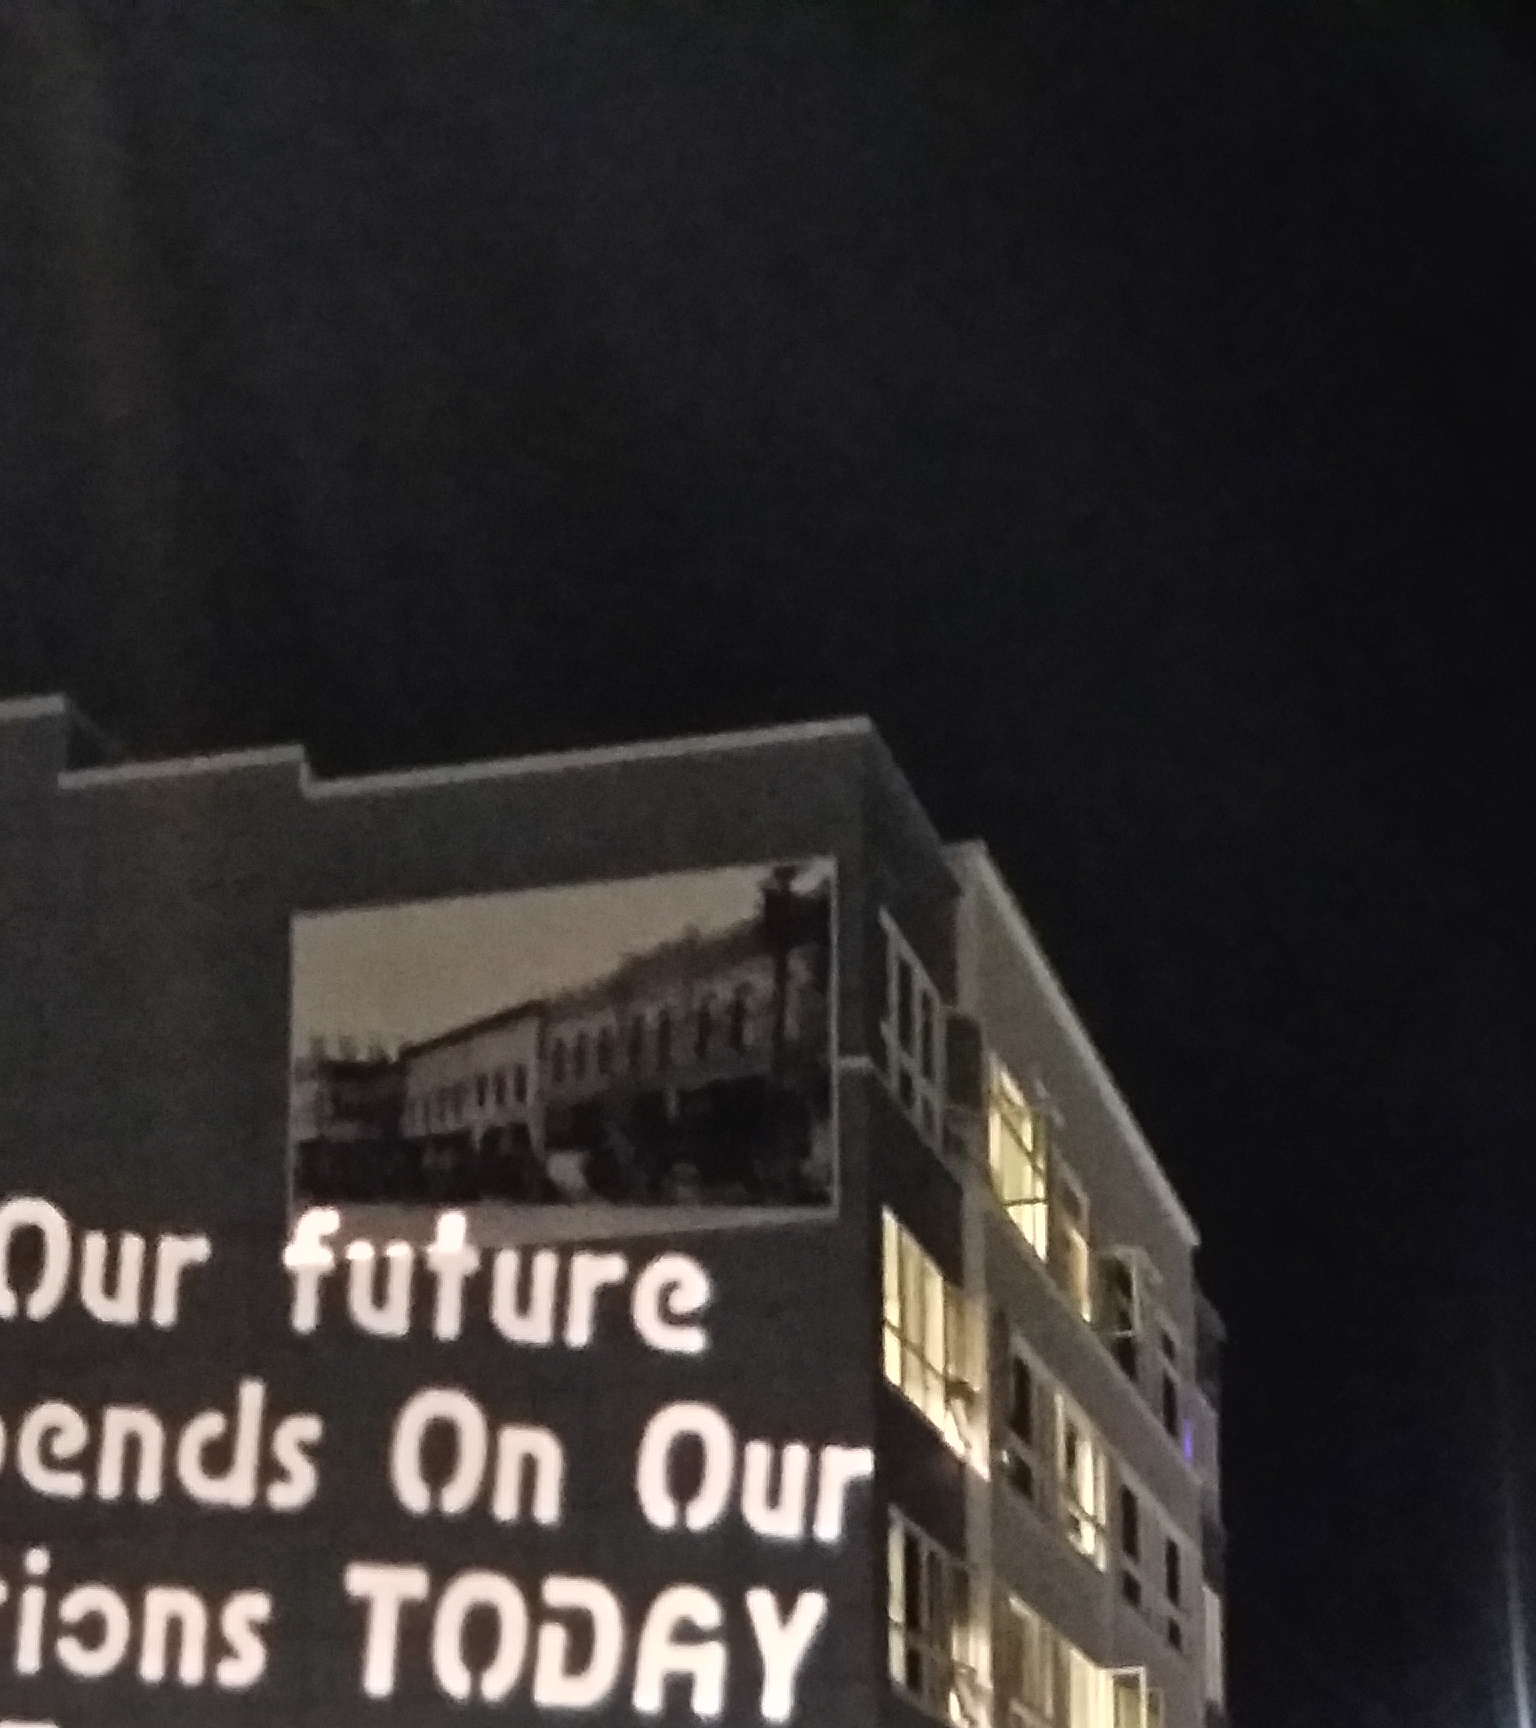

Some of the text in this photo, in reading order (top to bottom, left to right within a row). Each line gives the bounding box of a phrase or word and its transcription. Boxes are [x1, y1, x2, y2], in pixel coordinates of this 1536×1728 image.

[280, 1204, 712, 1356] future
[390, 1387, 566, 1528] On
[634, 1399, 877, 1547] Our
[342, 1561, 831, 1725] TODAY
